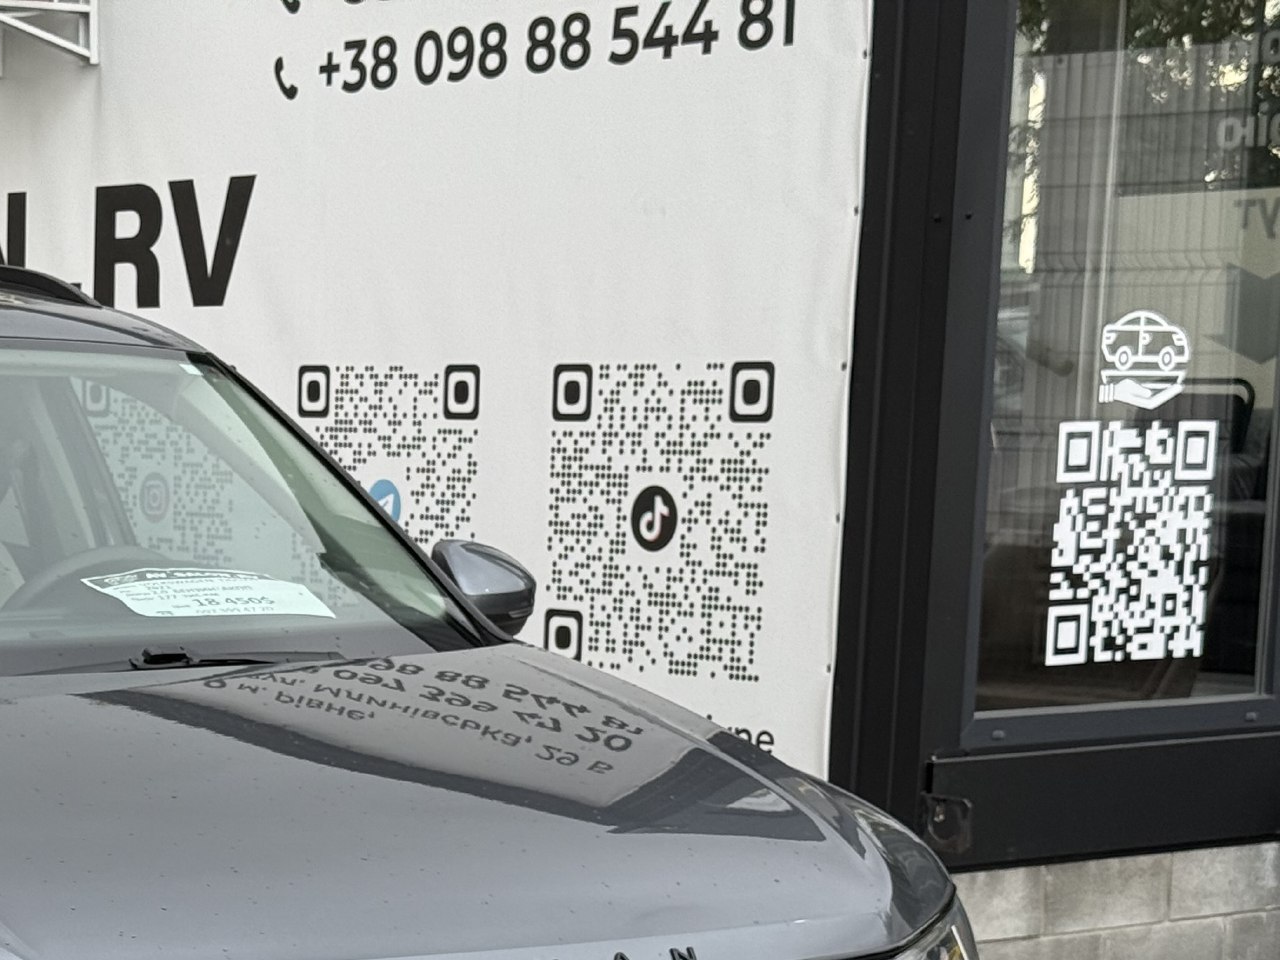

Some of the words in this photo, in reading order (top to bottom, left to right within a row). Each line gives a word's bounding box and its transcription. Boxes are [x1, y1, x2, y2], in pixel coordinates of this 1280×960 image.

[318, 36, 397, 93] +38
[414, 22, 507, 85] 098
[525, 15, 591, 74] 88
[608, 0, 719, 65] 544
[738, 0, 796, 51] 81
